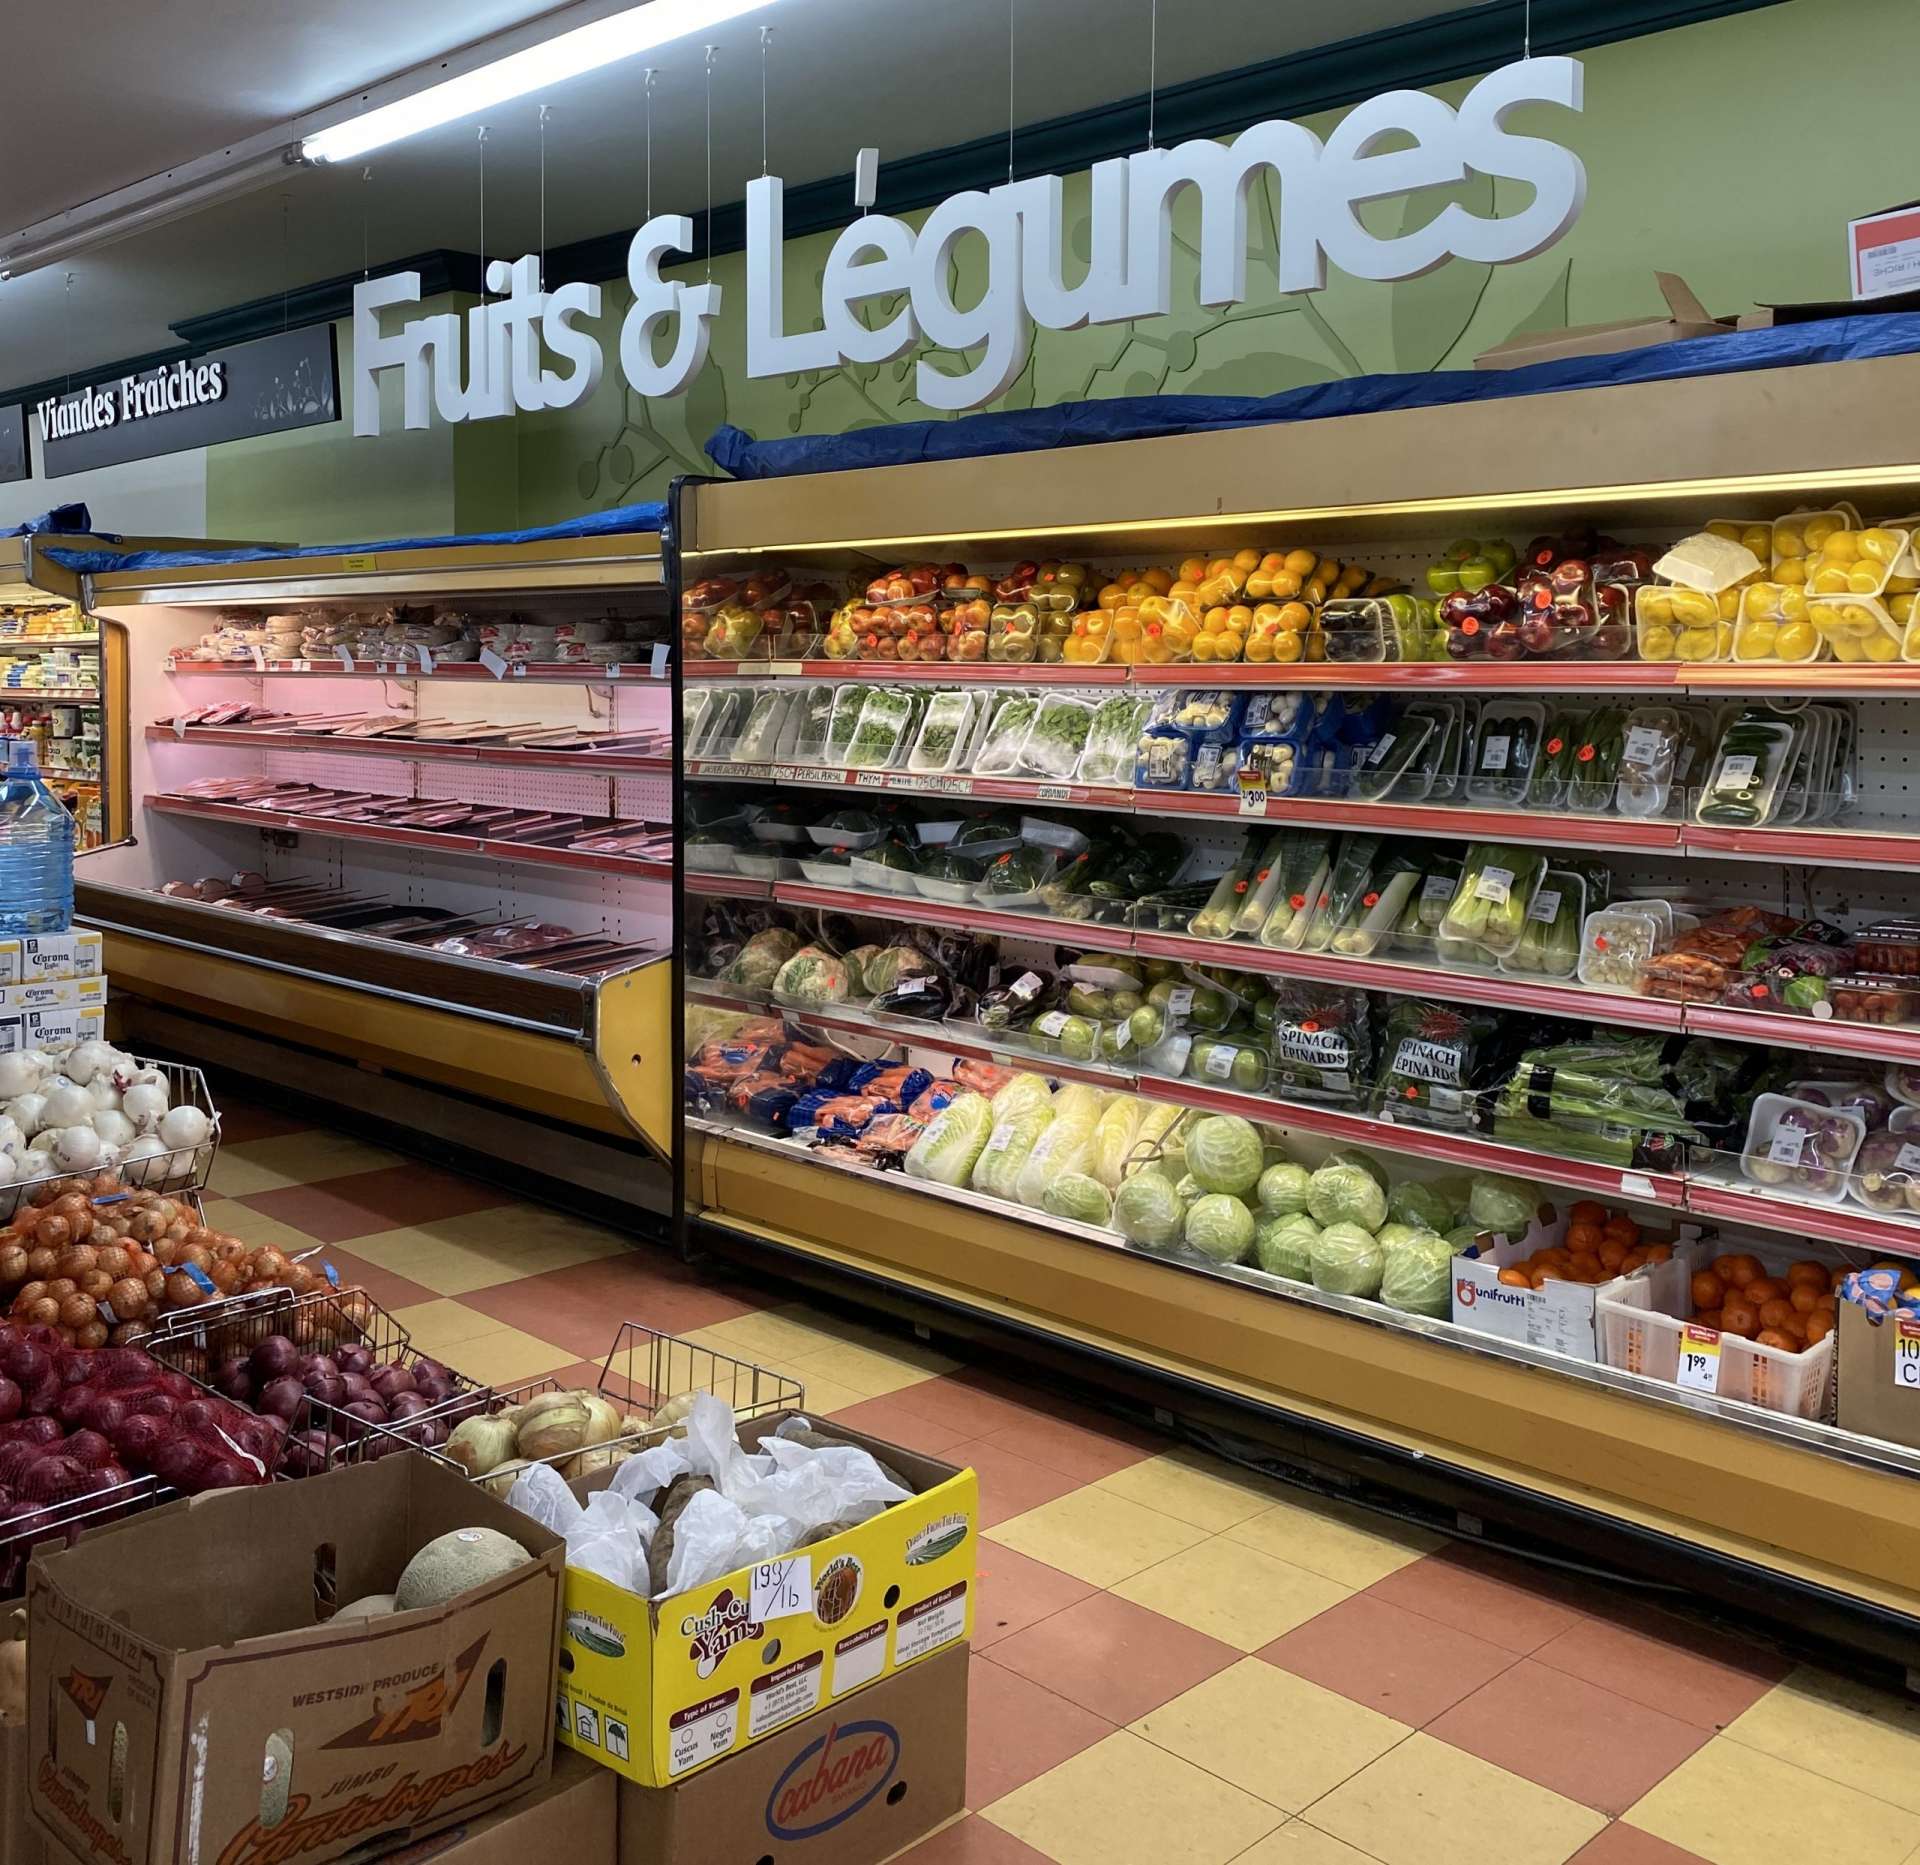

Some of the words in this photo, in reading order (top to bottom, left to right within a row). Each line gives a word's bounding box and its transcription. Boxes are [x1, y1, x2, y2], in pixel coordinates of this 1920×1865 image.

[353, 255, 602, 437] Fruits
[620, 214, 722, 397] &
[747, 57, 1586, 410] Légumes
[37, 387, 115, 441] Viandes
[120, 360, 223, 420] Fraîches
[33, 954, 69, 965] Corona
[25, 989, 54, 998] Corona
[35, 1026, 71, 1038] Corona
[1281, 1030, 1345, 1050] SPINACH
[1282, 1045, 1345, 1065] ÉPINARDS
[1401, 1040, 1456, 1067] SPINACH
[1396, 1057, 1457, 1083] ÉPINARDS
[1476, 1289, 1525, 1307] unifrutti
[681, 1599, 750, 1636] Cush-Cu
[292, 1685, 366, 1708] WESTSID
[372, 1663, 439, 1692] PRODUCE
[710, 1726, 732, 1741] Negro
[674, 1742, 698, 1758] Cuscus
[713, 1738, 728, 1750] Yam
[678, 1755, 694, 1767] Yam
[321, 1761, 399, 1799] JUMBO
